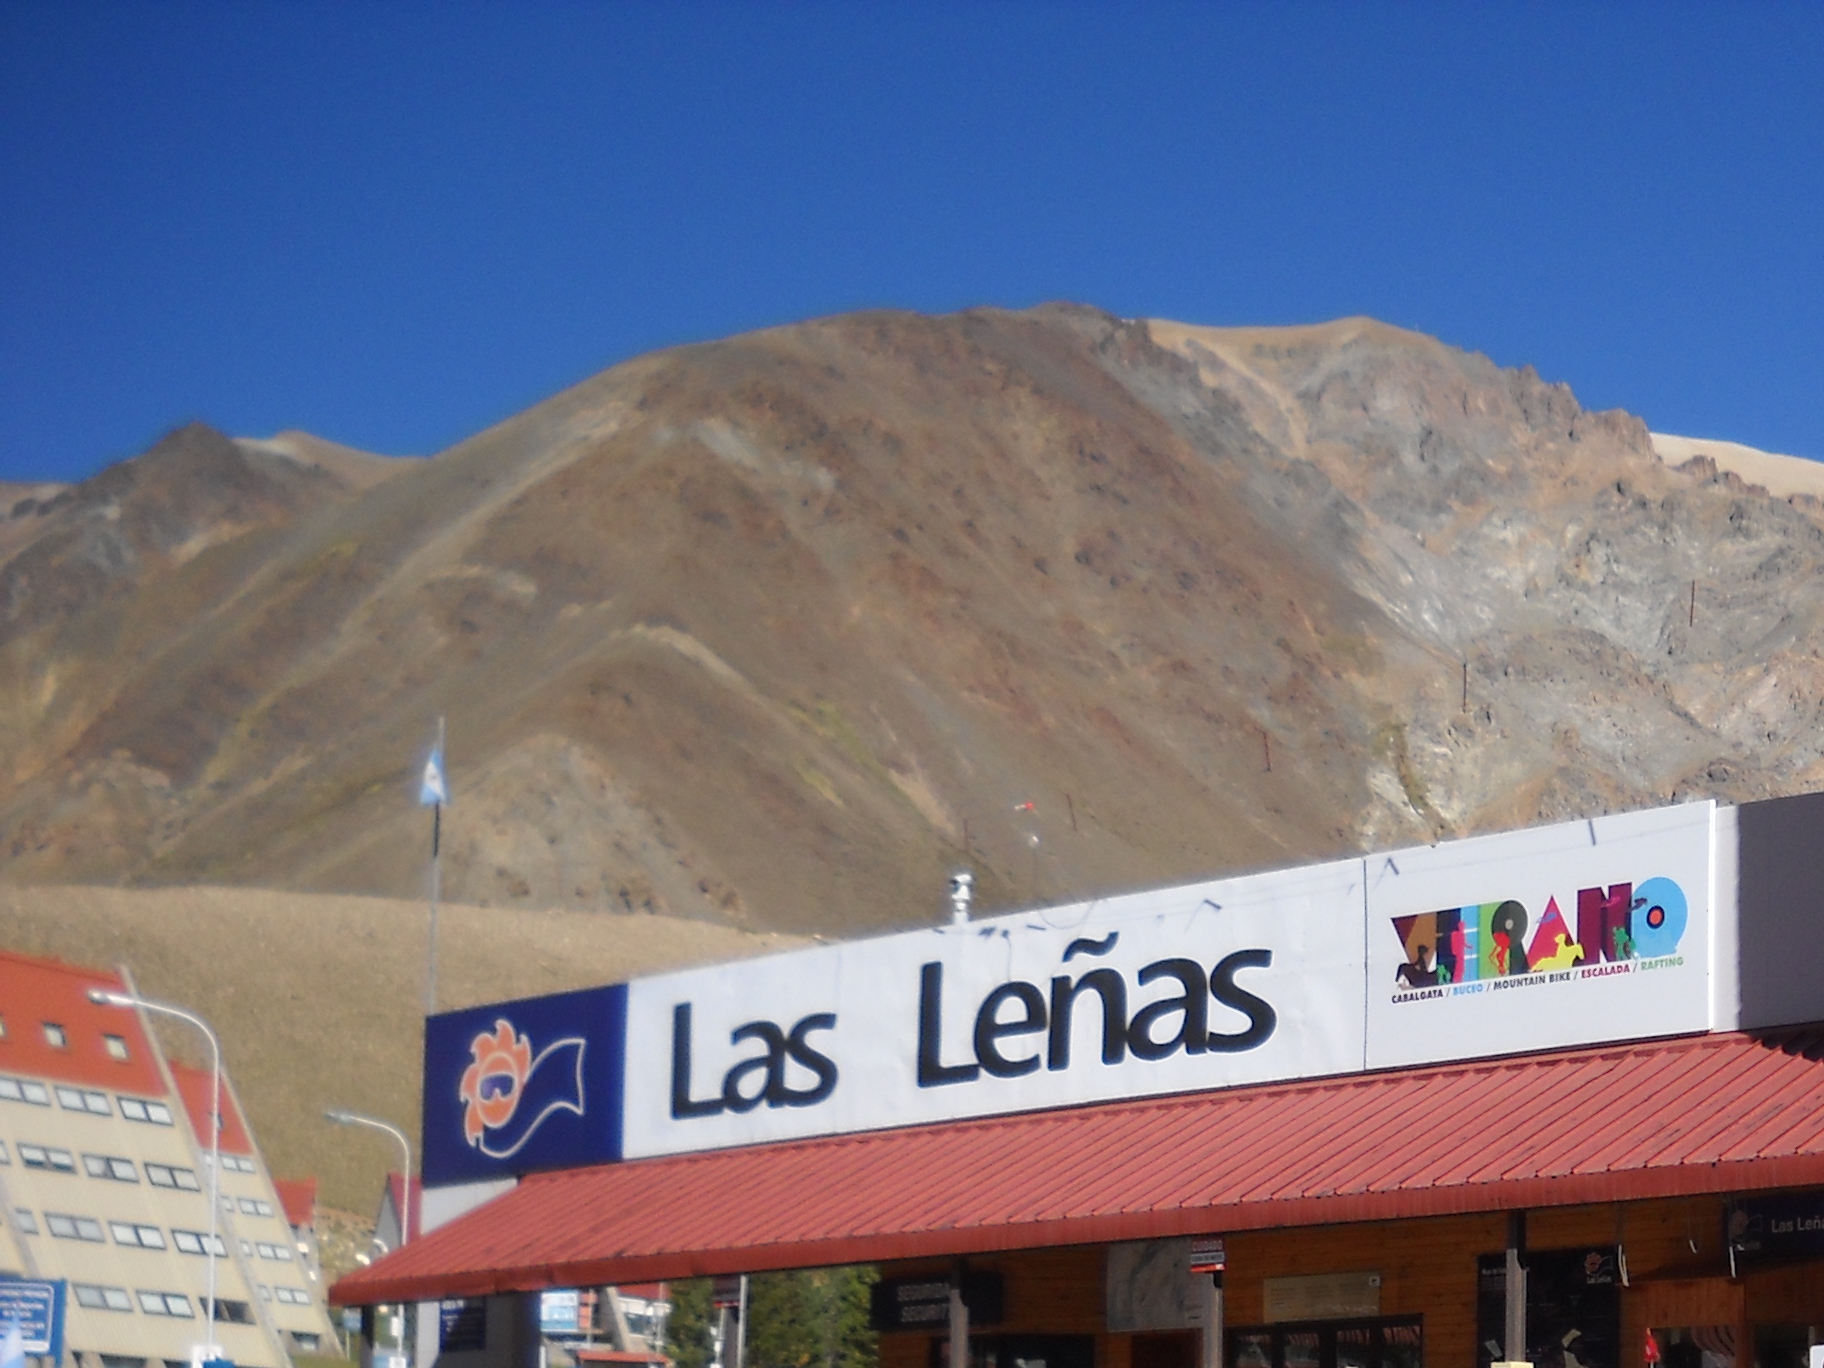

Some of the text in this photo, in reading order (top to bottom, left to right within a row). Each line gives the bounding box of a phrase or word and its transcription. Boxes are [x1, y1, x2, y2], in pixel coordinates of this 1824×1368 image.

[1391, 877, 1688, 987] VERANO
[1391, 988, 1444, 1004] CABALGATA
[1453, 983, 1483, 996] BUCEO
[1493, 974, 1546, 990] MOUNTAIN
[1549, 971, 1571, 983] BIKE
[1581, 963, 1631, 979] ESCALADA
[1641, 956, 1684, 971] RAFTING
[670, 931, 1278, 1120] Las Leñas
[1771, 1219, 1793, 1233] Las
